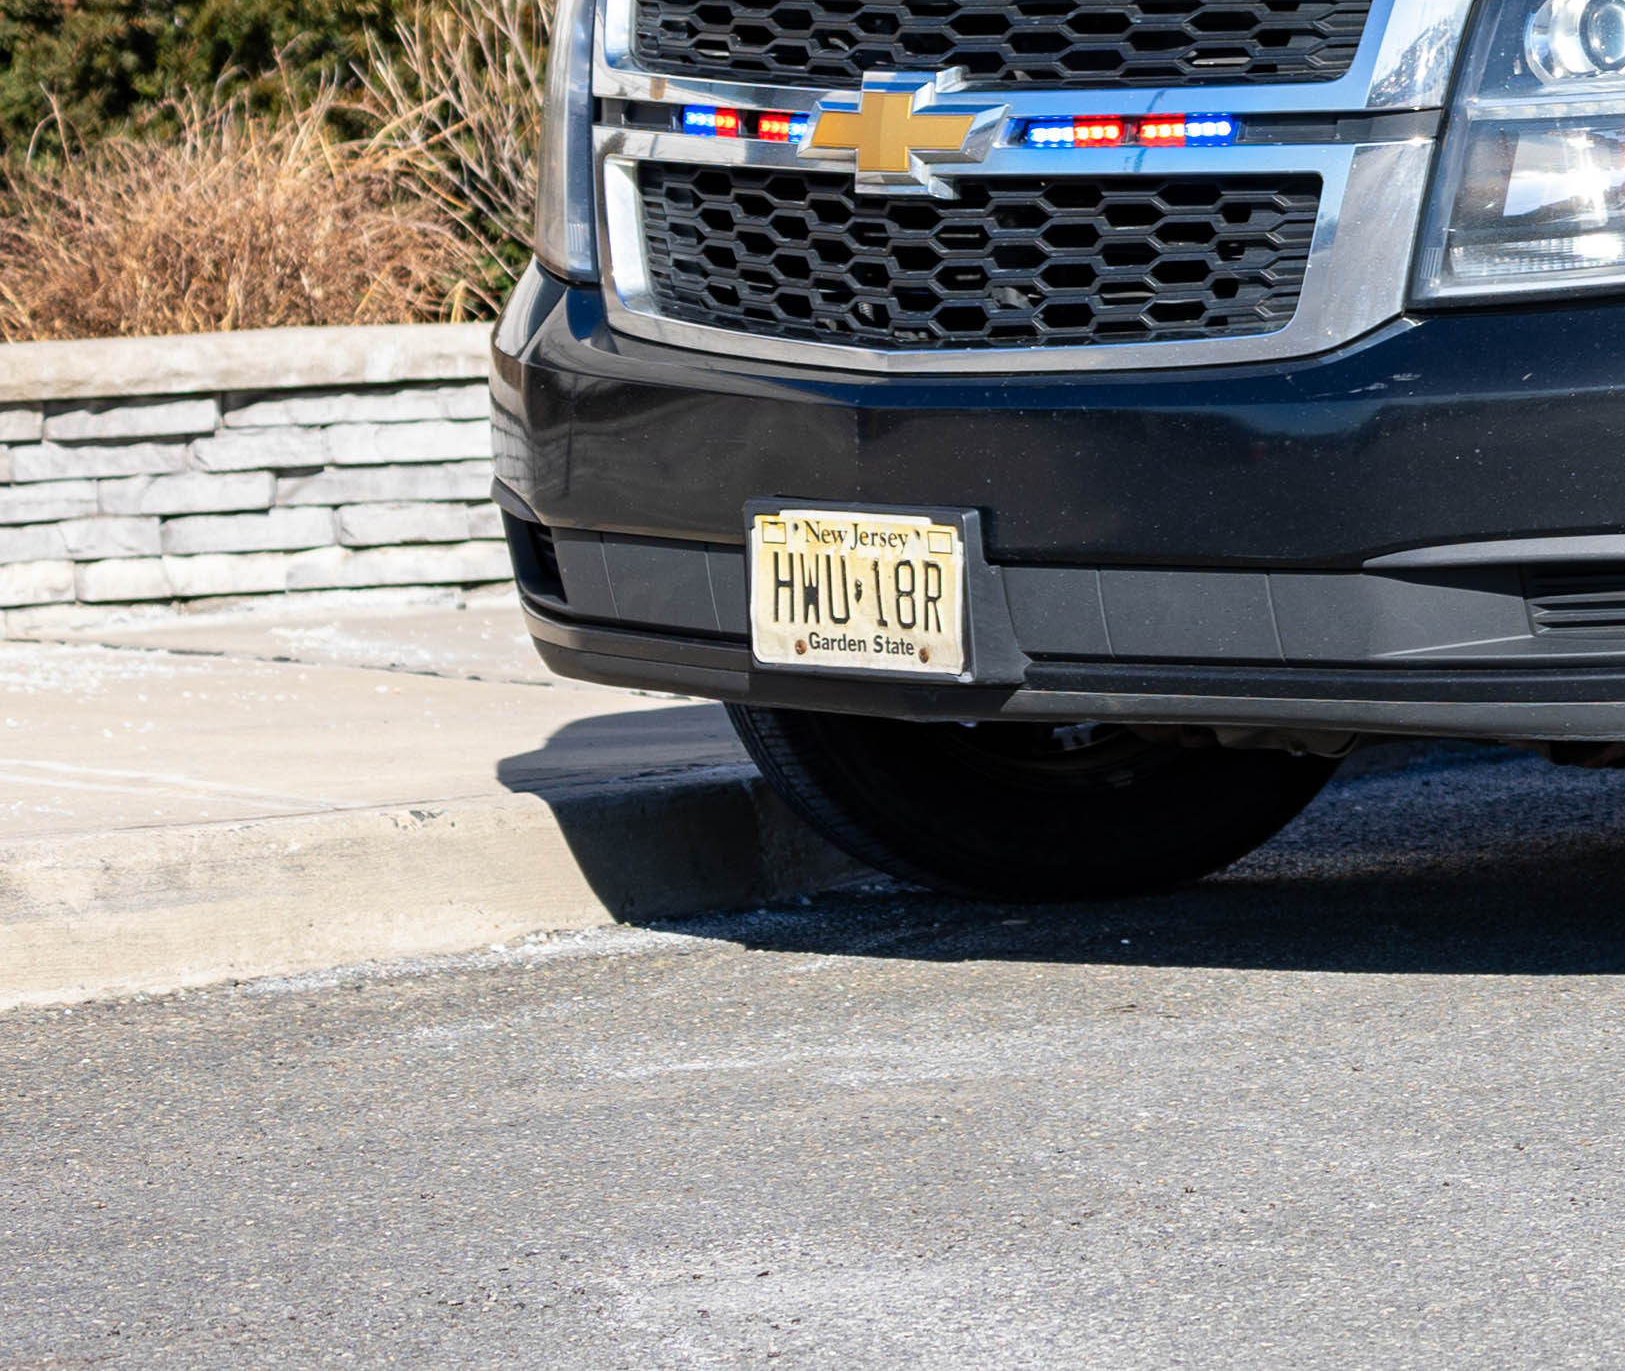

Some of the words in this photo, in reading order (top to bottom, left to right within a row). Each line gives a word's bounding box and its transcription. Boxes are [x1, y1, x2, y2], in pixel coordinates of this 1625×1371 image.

[805, 520, 848, 544] New
[850, 523, 909, 555] Jersey
[808, 632, 867, 653] Garden
[873, 636, 915, 656] State
